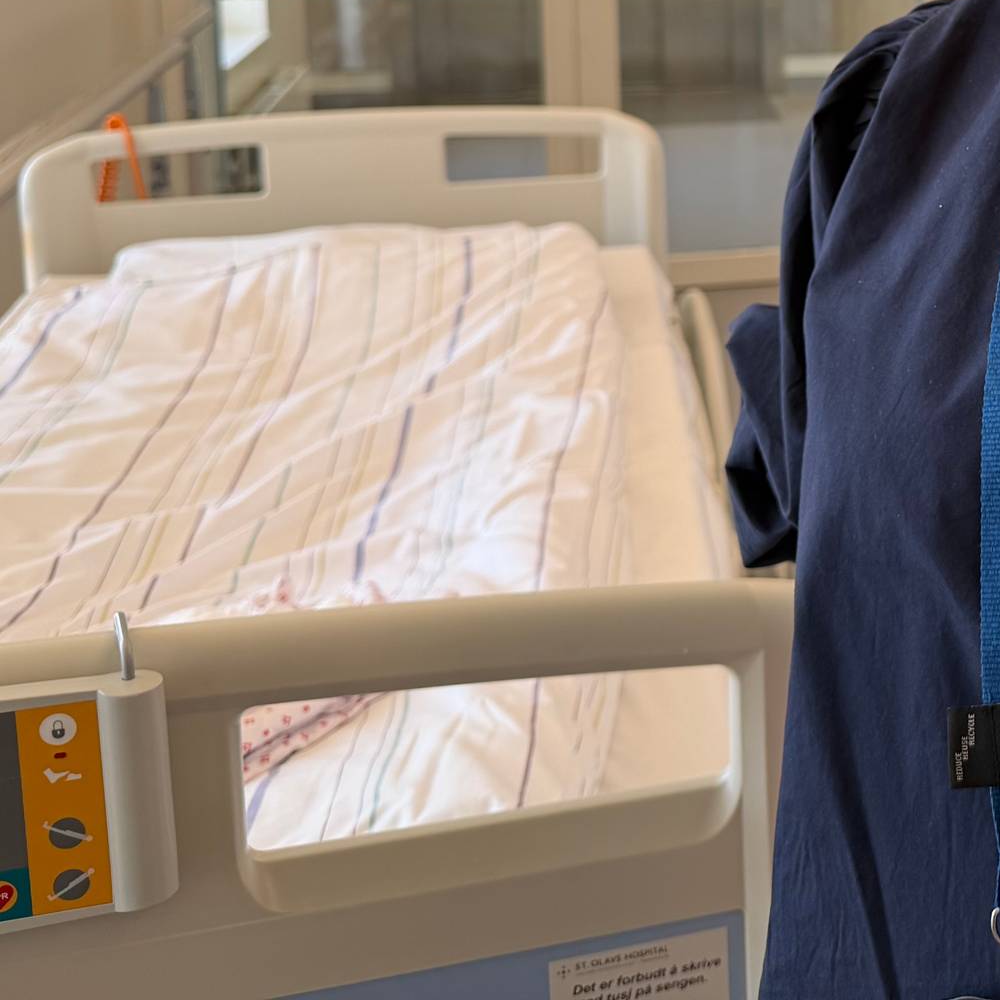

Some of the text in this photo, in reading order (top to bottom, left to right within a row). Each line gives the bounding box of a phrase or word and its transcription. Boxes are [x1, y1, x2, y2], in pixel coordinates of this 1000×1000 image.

[955, 752, 963, 781] REDUCE
[591, 954, 621, 967] OLAVS
[573, 982, 596, 996] Det
[600, 979, 613, 990] er
[617, 967, 667, 986] forbudt
[670, 963, 678, 975] å
[682, 957, 721, 972] skrive
[635, 983, 652, 999] på
